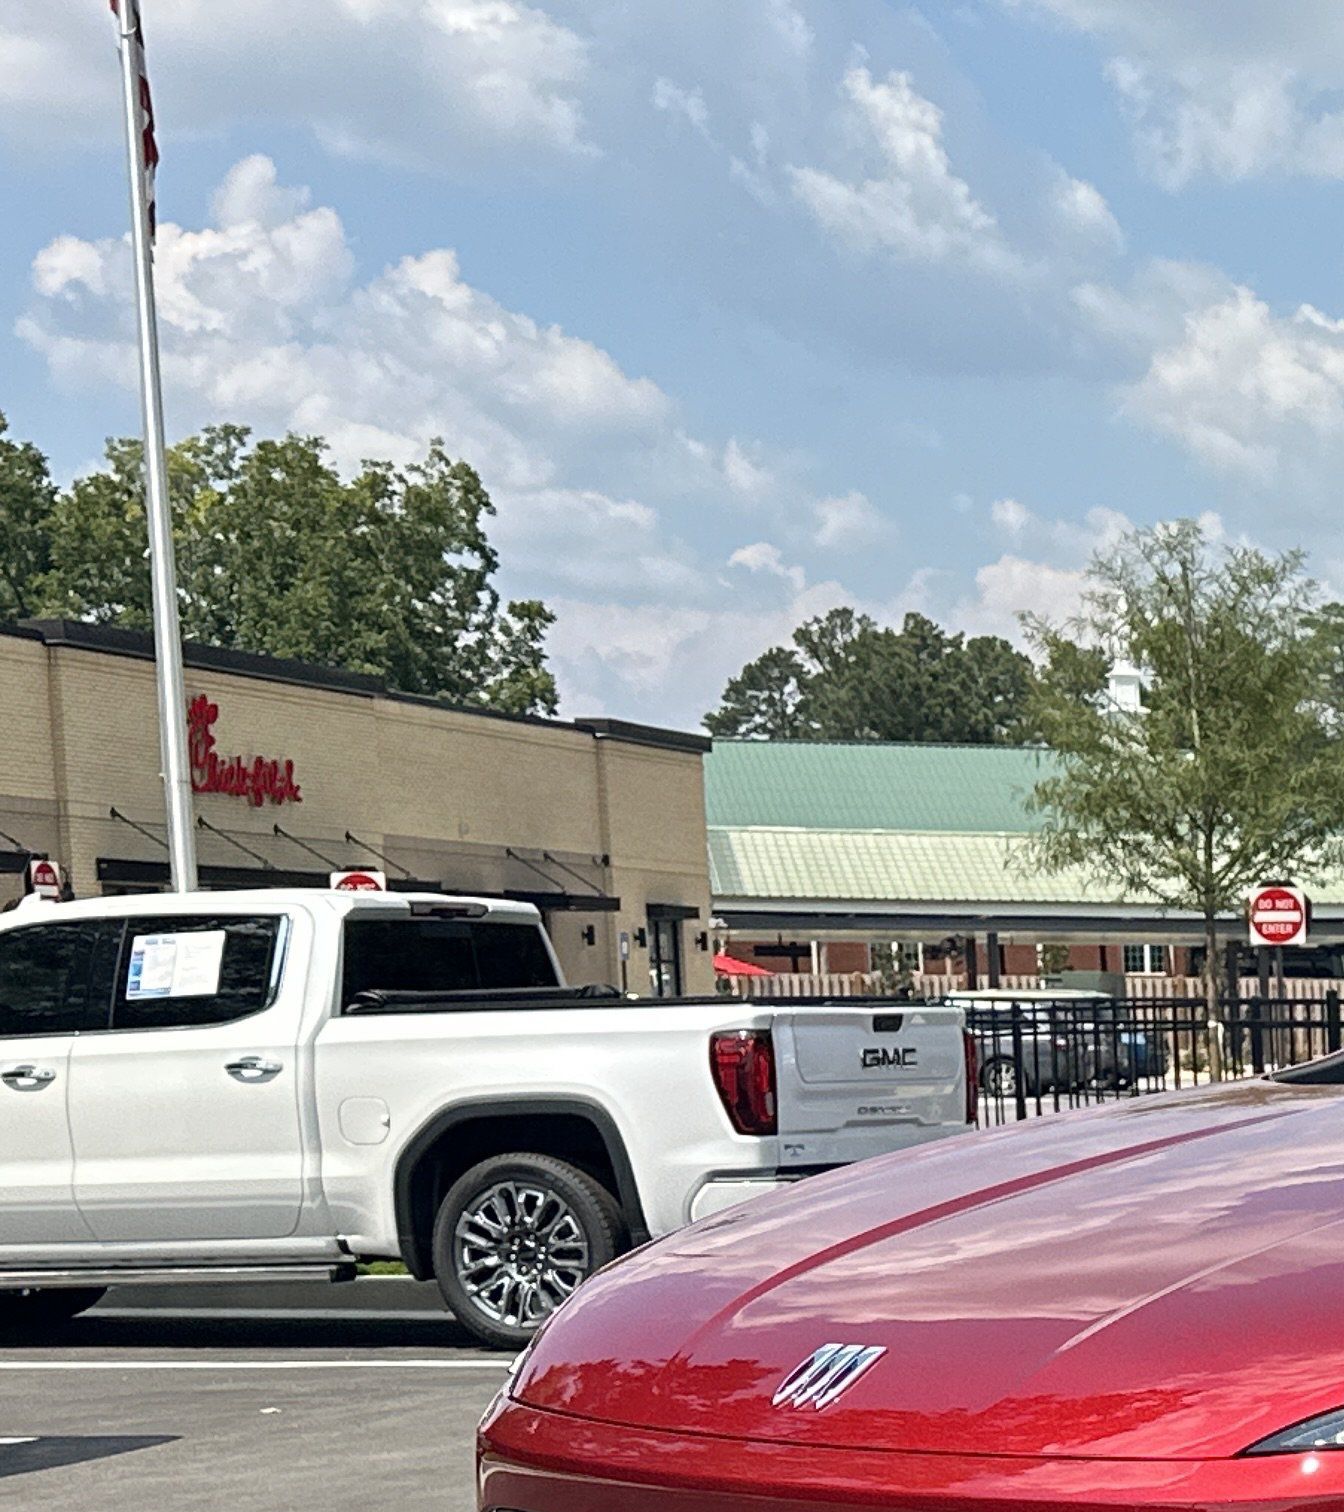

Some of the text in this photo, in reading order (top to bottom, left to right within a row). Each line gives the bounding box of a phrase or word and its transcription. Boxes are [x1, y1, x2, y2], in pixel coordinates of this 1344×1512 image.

[1257, 898, 1295, 910] DO NOT
[1261, 923, 1294, 935] ENTER
[862, 1047, 918, 1068] GMC
